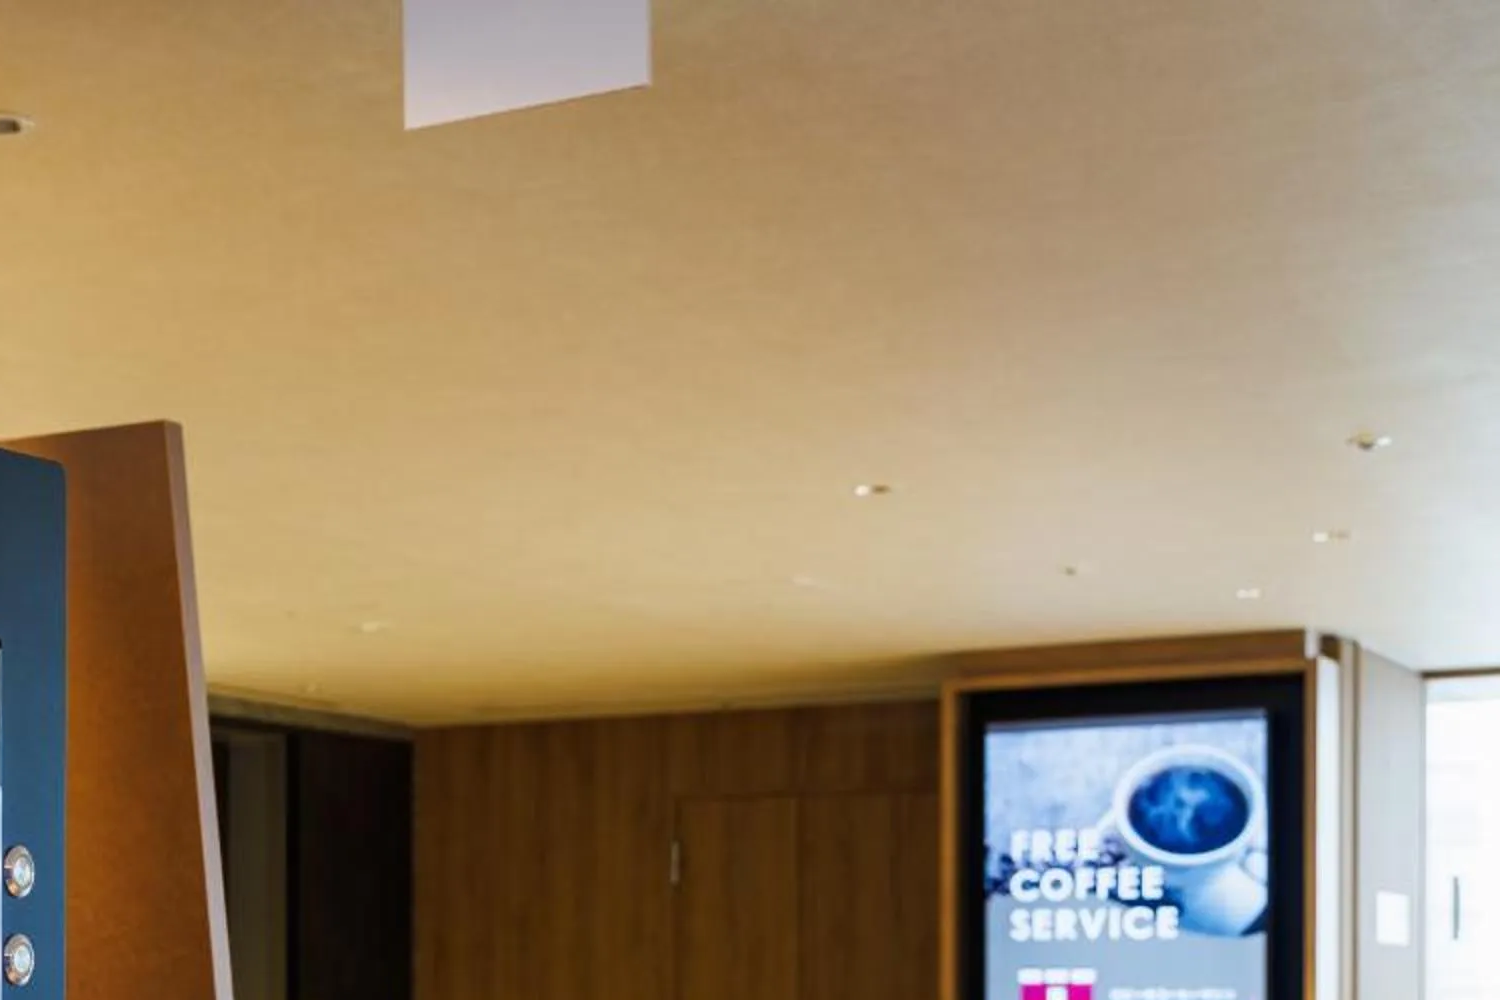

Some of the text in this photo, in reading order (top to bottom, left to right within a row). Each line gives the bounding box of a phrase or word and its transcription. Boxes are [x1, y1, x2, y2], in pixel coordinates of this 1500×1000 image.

[1011, 829, 1100, 863] FREE
[1010, 866, 1164, 902] COFFEE
[1010, 906, 1179, 942] SERVICE
